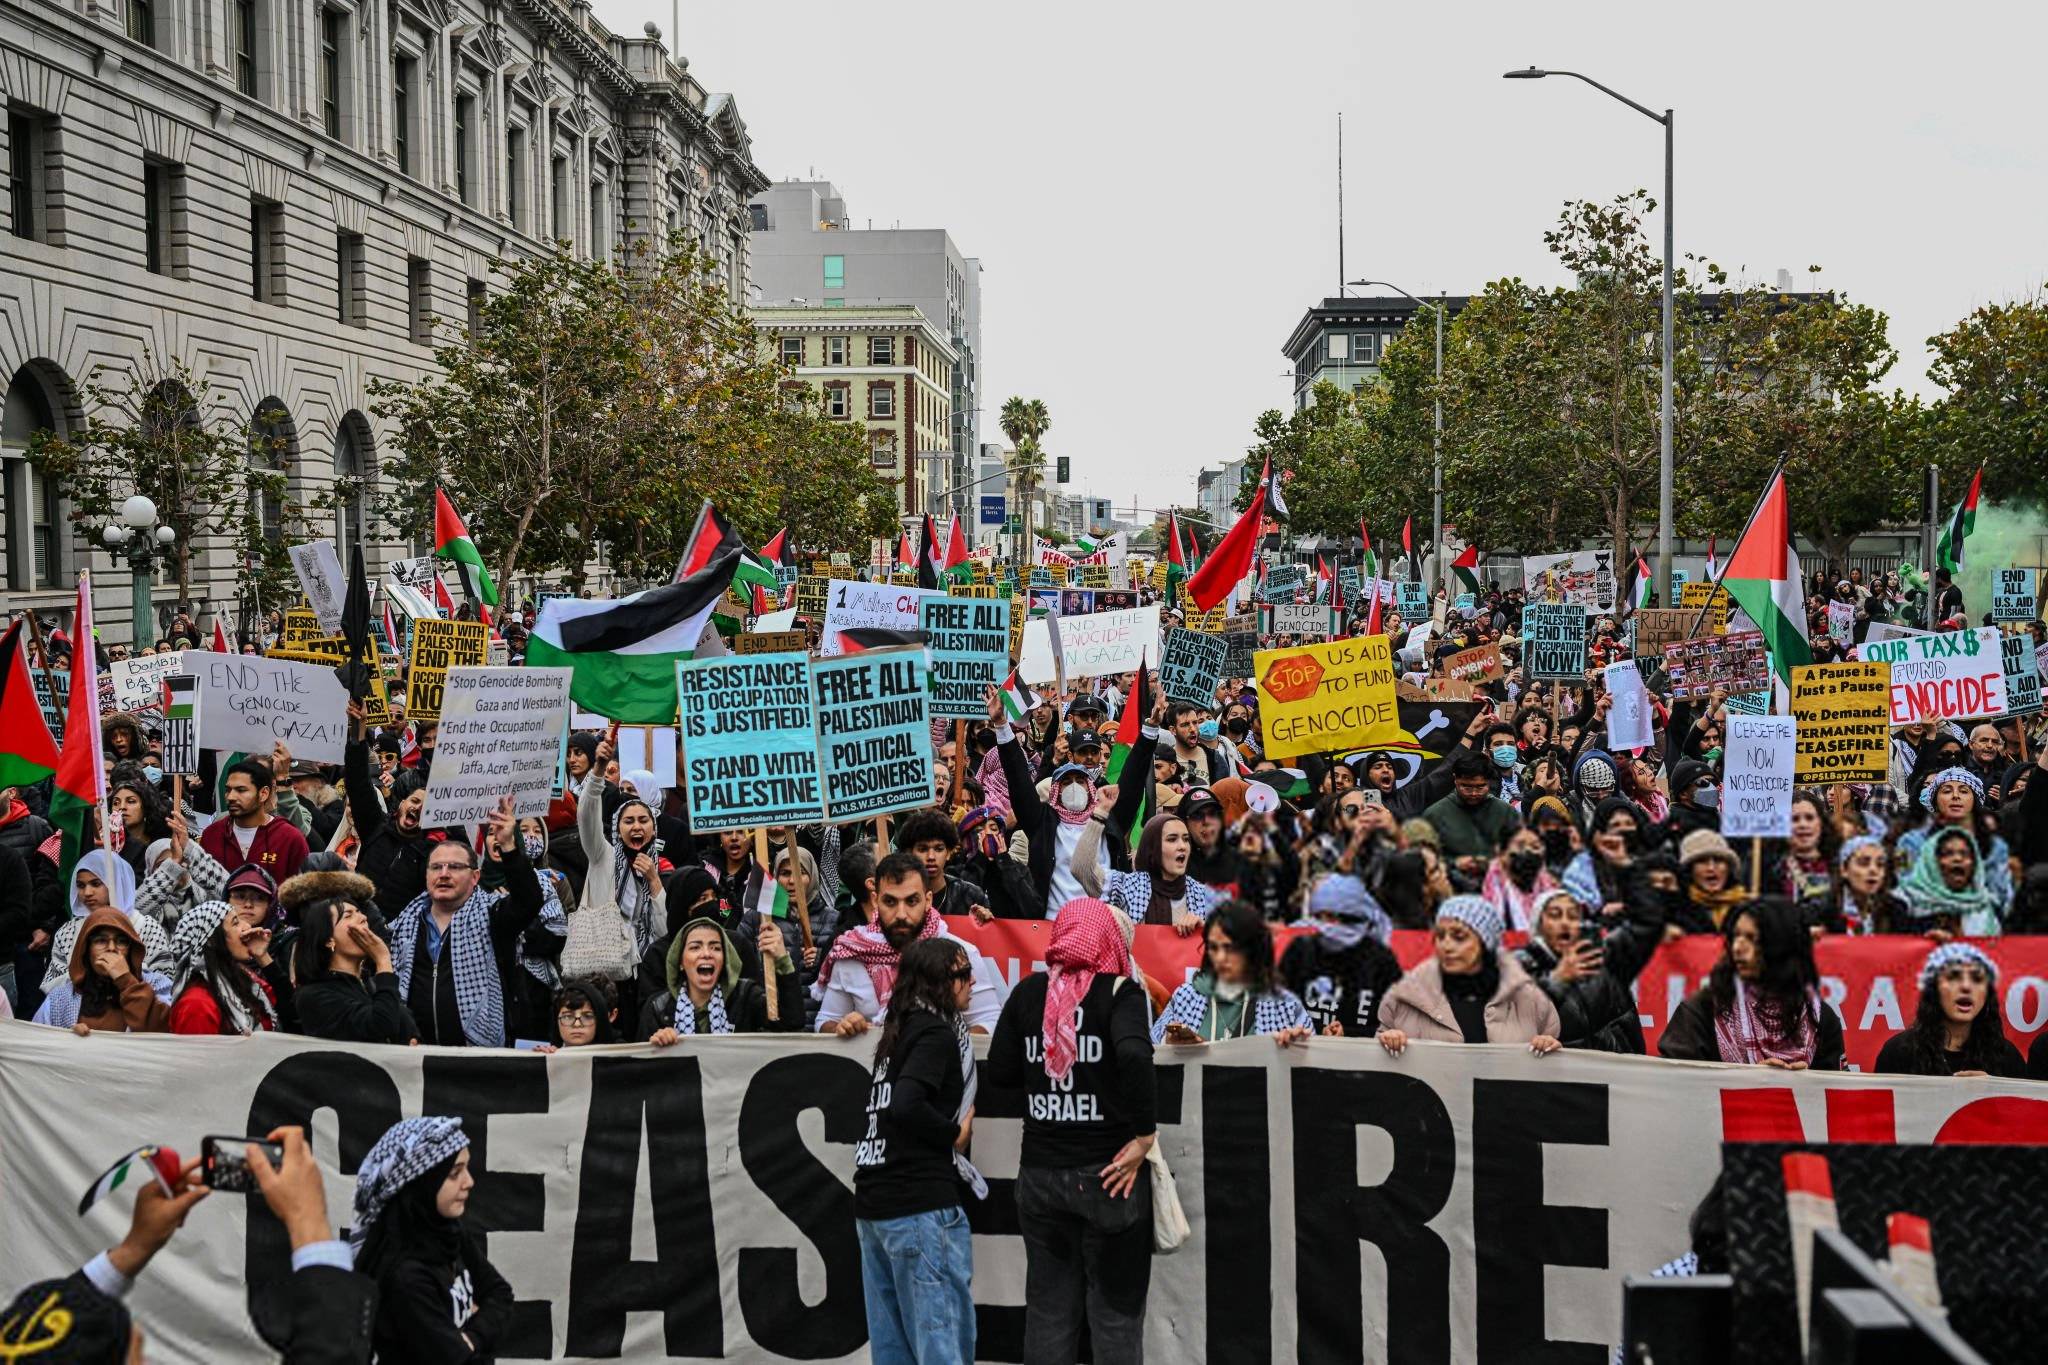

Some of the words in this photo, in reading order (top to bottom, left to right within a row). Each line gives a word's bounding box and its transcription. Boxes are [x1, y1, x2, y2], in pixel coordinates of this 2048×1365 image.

[1083, 567, 1096, 576] FREE
[1097, 565, 1108, 574] ALL
[2001, 570, 2026, 583] END
[798, 576, 830, 586] PALESTINE
[1403, 584, 1420, 593] END
[2003, 583, 2025, 595] ALL
[798, 586, 816, 596] WILL
[819, 587, 829, 597] BE
[836, 585, 847, 609] 1
[1405, 593, 1419, 602] ALL
[1283, 605, 1320, 617] STOP
[1398, 603, 1411, 611] U.S.
[1413, 603, 1426, 611] AID
[1537, 605, 1562, 615] STAND
[1564, 605, 1585, 616] WITH
[1994, 596, 2013, 608] U.S.
[2015, 596, 2033, 608] AID
[1994, 608, 2003, 616] TO
[2004, 607, 2034, 616] ISRAEL!
[288, 616, 321, 629] RESIST
[925, 604, 968, 629] FREE
[973, 605, 1005, 631] ALL
[1111, 612, 1143, 626] THE
[1275, 621, 1329, 632] GENOCIDE
[1537, 615, 1584, 627] PALESTINE!
[1640, 611, 1687, 630] RIGHT
[418, 621, 454, 636] STAND
[457, 624, 485, 638] WITH
[1051, 627, 1130, 648] ENOCIDE
[1536, 627, 1563, 641] END
[1564, 627, 1584, 641] THE
[417, 635, 484, 652] PALESTINE!
[744, 638, 767, 650] END
[774, 635, 799, 647] THE
[926, 633, 1005, 653] PALESTINIAN
[1171, 628, 1204, 645] STAND
[1205, 635, 1227, 654] WITH
[1535, 642, 1583, 652] OCCUPATION
[2002, 637, 2023, 657] ND
[415, 649, 449, 669] END
[453, 653, 484, 666] THE
[1085, 644, 1136, 664] GAZA
[1168, 639, 1225, 664] PALESTINE!
[1327, 648, 1355, 666] US
[1360, 645, 1388, 661] AID
[1456, 649, 1486, 667] STOP
[1866, 641, 1909, 664] OUR
[128, 656, 183, 675] BOMBIN
[932, 661, 997, 682] POLITICAL
[1165, 648, 1195, 669] END
[1197, 656, 1221, 679] THE
[1450, 656, 1495, 680] BOMBING
[1535, 652, 1582, 672] NOW!
[210, 662, 259, 692] END
[270, 668, 310, 693] THE
[682, 662, 808, 693] RESISTANCE
[1161, 666, 1188, 685] U.S.
[1190, 671, 1214, 693] AID
[1270, 665, 1318, 692] STOP
[1320, 677, 1349, 694] TO
[1354, 669, 1393, 689] FUND
[1804, 669, 1815, 680] A
[1820, 667, 1860, 680] Pause
[1864, 665, 1876, 677] is
[1892, 661, 1946, 684] FUND
[142, 684, 152, 694] IS
[453, 675, 477, 691] Stop
[479, 675, 525, 689] Genocide
[525, 676, 563, 691] Bombing
[816, 665, 874, 706] FREE
[880, 660, 922, 698] ALL
[1795, 684, 1825, 699] Just
[1829, 685, 1836, 694] a
[1841, 681, 1884, 693] Pause
[2017, 676, 2037, 692] AID
[228, 694, 309, 715] GENOCIDE
[475, 698, 499, 712] Gaza
[501, 699, 519, 712] and
[521, 696, 566, 710] Westbank!
[683, 694, 704, 713] TO
[708, 687, 809, 711] OCCUPATION
[1171, 684, 1211, 706] ISRAEL!
[1889, 672, 2002, 723] ENOCIDE
[2007, 694, 2040, 709] SRAEL!
[246, 716, 266, 726] ON
[686, 714, 707, 737] IS
[711, 707, 812, 734] JUSTIFIED!
[819, 697, 924, 736] PALESTINIAN
[1271, 701, 1394, 743] GENOCIDE
[1794, 710, 1817, 721] We
[1821, 705, 1887, 721] Demand:
[164, 720, 193, 746] SAVE
[446, 721, 466, 734] End
[469, 721, 486, 734] the
[490, 719, 544, 735] Occupation!
[1734, 721, 1791, 740] CEASEFIRE
[1796, 725, 1887, 739] PERMANENT
[443, 743, 456, 755] PS
[458, 742, 484, 757] Right
[487, 740, 497, 752] of
[540, 738, 560, 750] Haifa
[832, 732, 917, 770] POLITICAL
[1796, 738, 1885, 754] CEASEFIRE
[165, 746, 193, 773] GAZA
[691, 754, 759, 782] STAND
[763, 751, 817, 776] WITH
[1747, 747, 1775, 770] NOW
[1811, 754, 1865, 769] NOW!
[458, 761, 485, 775] Jaffa,
[487, 762, 510, 776] Acre,
[1803, 771, 1873, 782] @PSLBayArea
[434, 787, 450, 798] UN
[512, 778, 550, 796] genocide!
[828, 758, 927, 800] PRISONERS!
[693, 777, 820, 812] PALESTINE
[831, 796, 886, 815] A.N.S.W.E.R.
[886, 789, 928, 804] Coalition
[433, 808, 457, 823] Stop
[518, 799, 549, 815] disinfo!
[708, 818, 727, 827] Party
[728, 817, 738, 825] for
[740, 814, 773, 824] Socialism
[774, 812, 787, 821] and
[788, 809, 823, 820] Liberation
[1076, 1035, 1103, 1063] ID
[1028, 1093, 1104, 1121] ISRAEL
[246, 1049, 1611, 1365] CEASIRE
